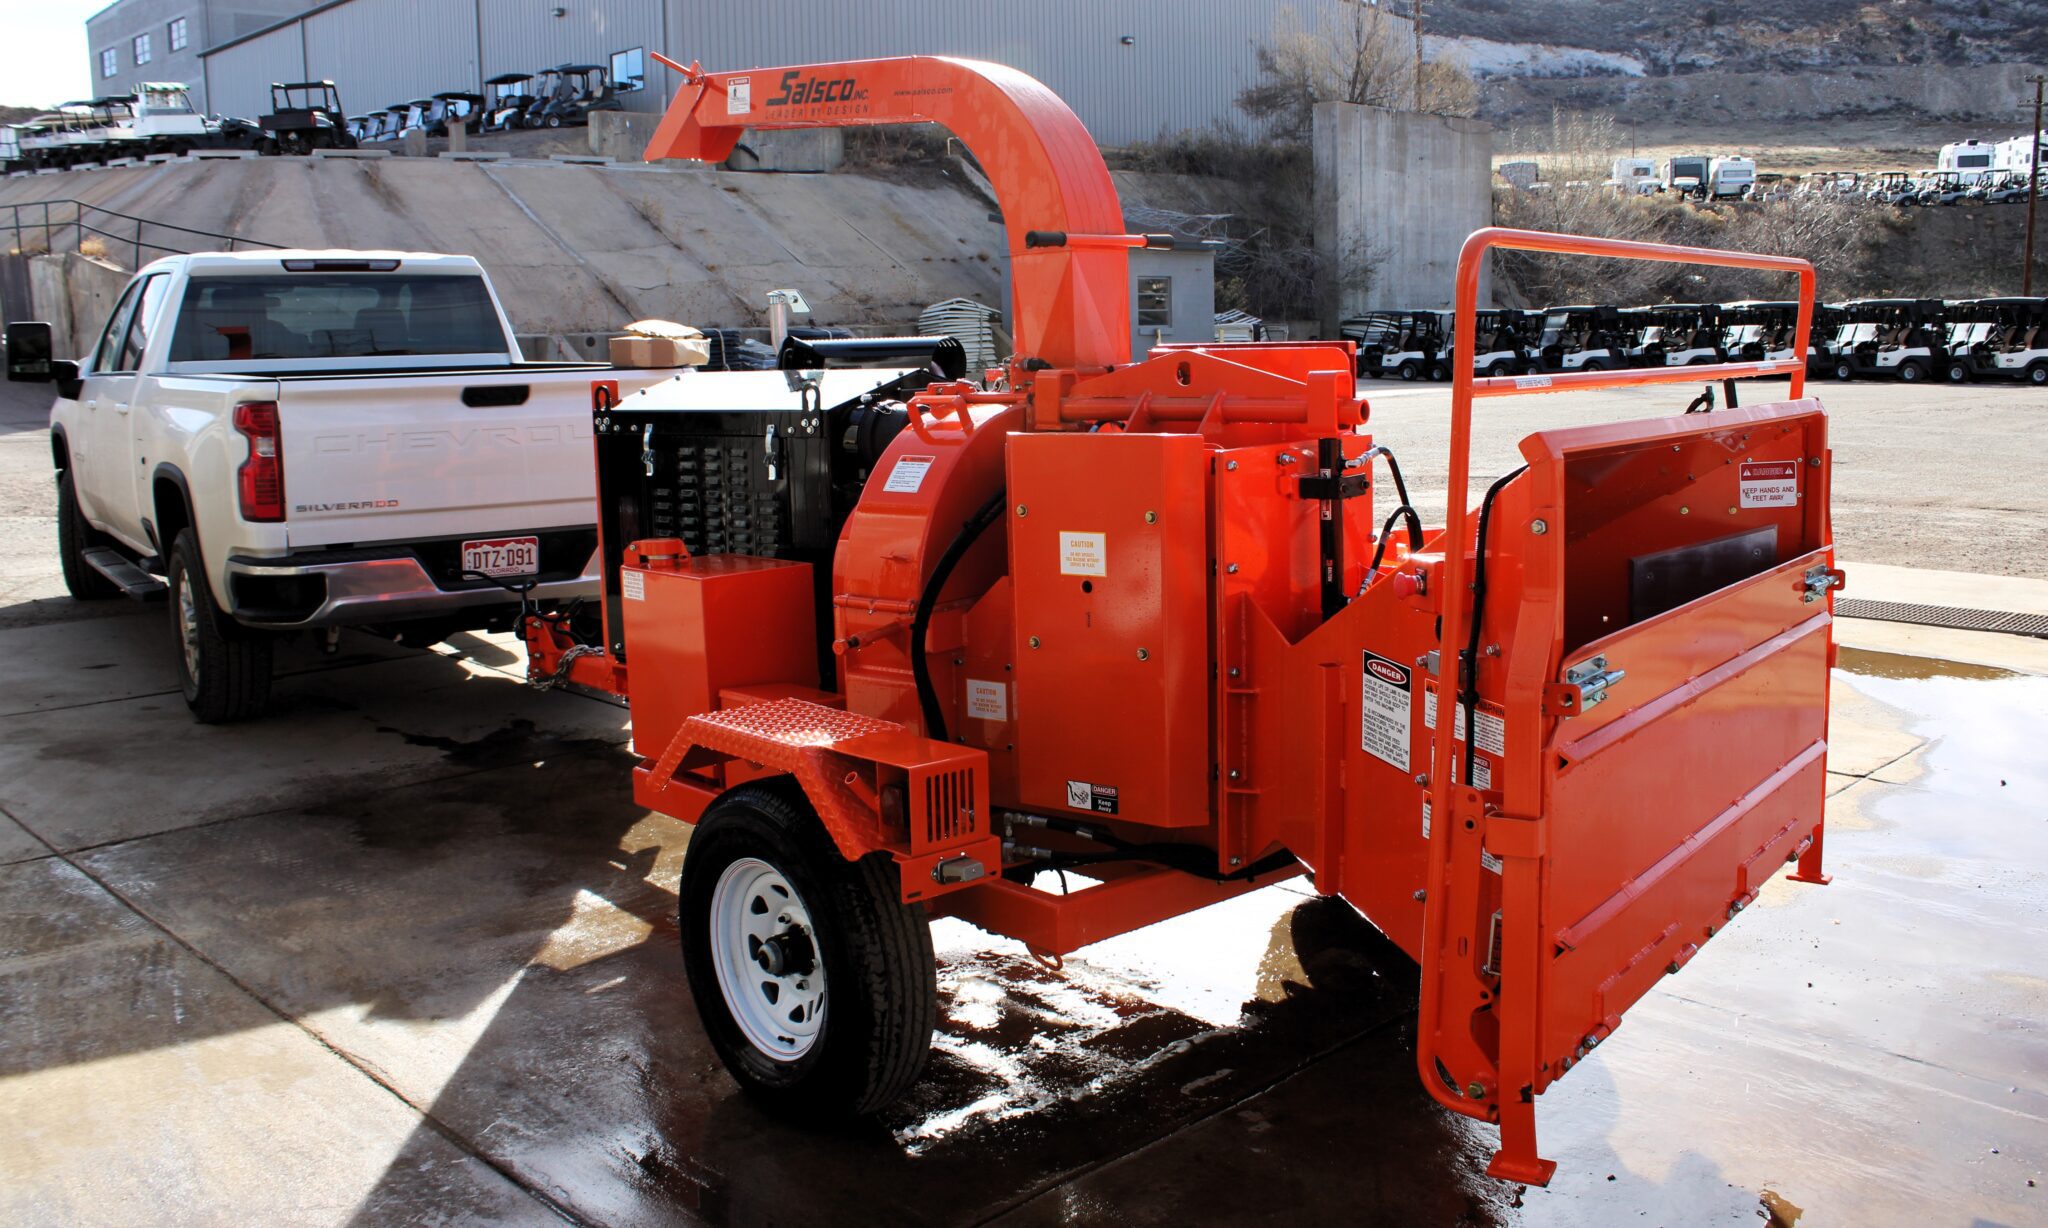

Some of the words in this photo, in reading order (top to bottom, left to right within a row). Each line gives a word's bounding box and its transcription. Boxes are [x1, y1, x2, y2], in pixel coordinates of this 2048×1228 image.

[766, 72, 856, 106] Salsco
[894, 88, 953, 96] www.salsco.com
[765, 108, 803, 120] LEADER
[811, 108, 821, 117] BY
[827, 104, 869, 116] DESIGN
[314, 424, 595, 453] CHEVROL
[1742, 487, 1758, 495] KEEP
[1760, 486, 1780, 494] HANDS
[296, 500, 399, 513] SILVERADO
[1070, 540, 1094, 549] CAUTION
[484, 566, 520, 574] COLORADO
[1372, 662, 1401, 680] DANGER
[1478, 700, 1505, 717] WARNIN
[1093, 786, 1116, 795] DANGER
[1098, 805, 1112, 813] Away
